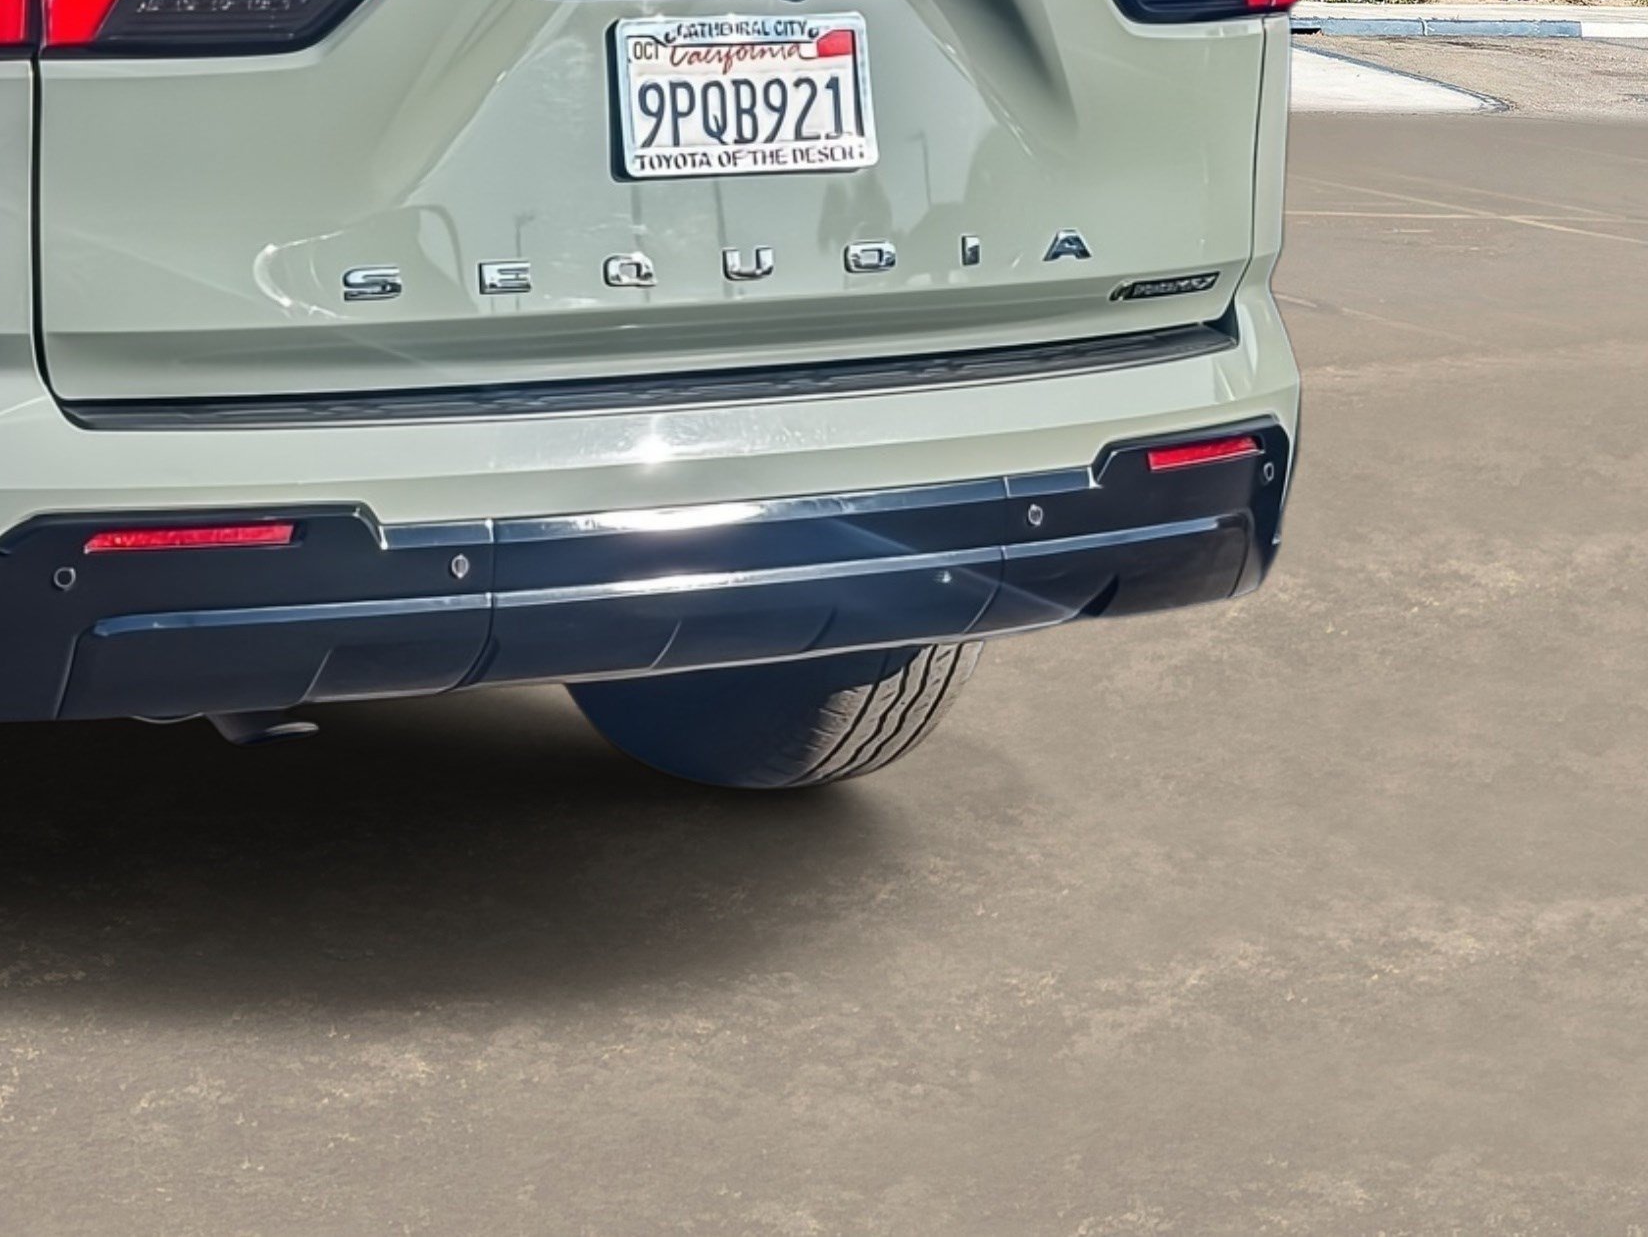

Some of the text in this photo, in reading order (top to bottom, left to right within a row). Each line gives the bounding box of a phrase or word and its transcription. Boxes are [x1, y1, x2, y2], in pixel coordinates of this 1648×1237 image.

[773, 18, 807, 37] CITY
[669, 43, 818, 75] California
[638, 75, 844, 148] 9PQB921
[634, 151, 712, 170] TOYOTA
[718, 150, 743, 168] OF
[747, 148, 788, 166] THE
[342, 228, 1093, 301] SEQUOIA
